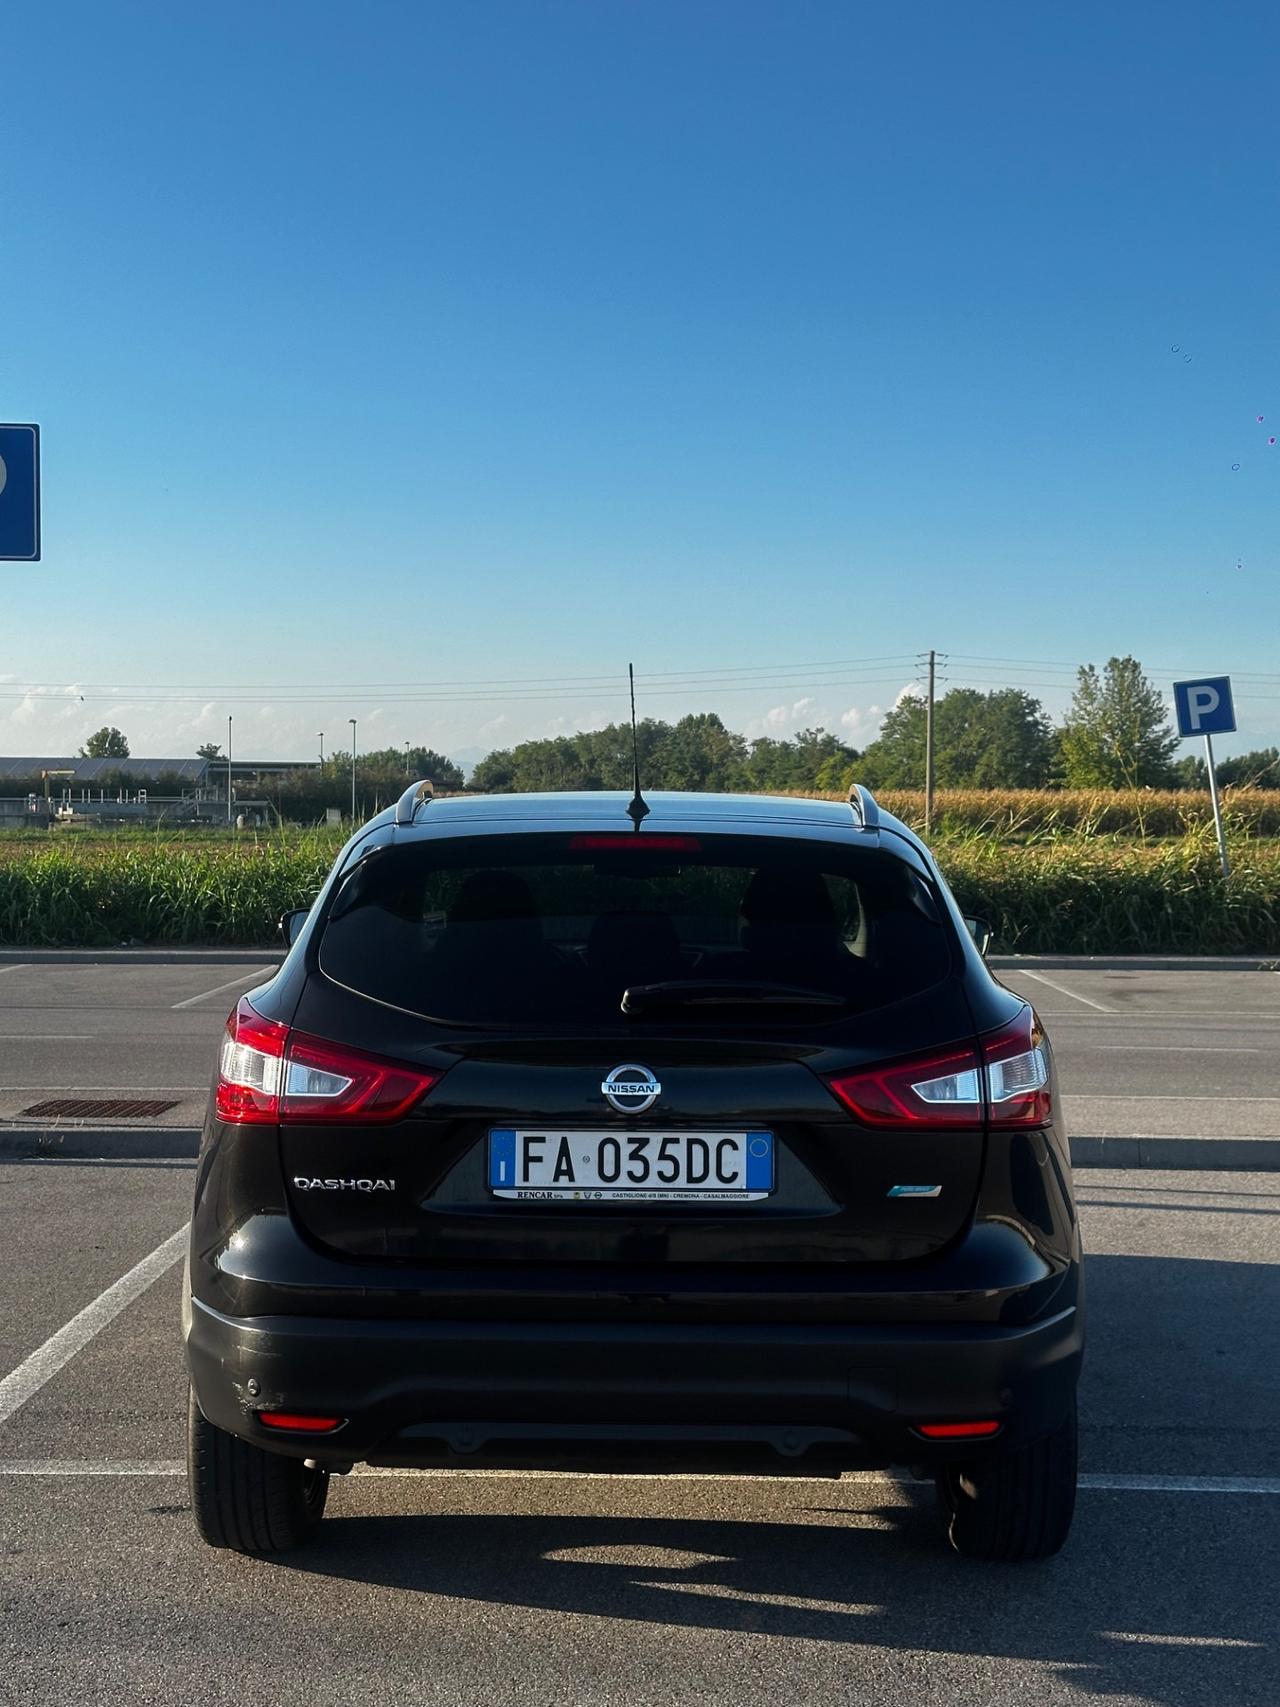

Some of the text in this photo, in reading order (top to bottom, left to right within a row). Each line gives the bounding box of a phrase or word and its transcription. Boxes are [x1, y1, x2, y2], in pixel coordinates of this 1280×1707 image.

[1187, 685, 1219, 730] P
[608, 1085, 655, 1093] NISSAN
[523, 1136, 739, 1184] FA 035DC
[500, 1160, 506, 1181] I
[293, 1176, 396, 1192] QASHQAI
[517, 1191, 553, 1199] RENCAR
